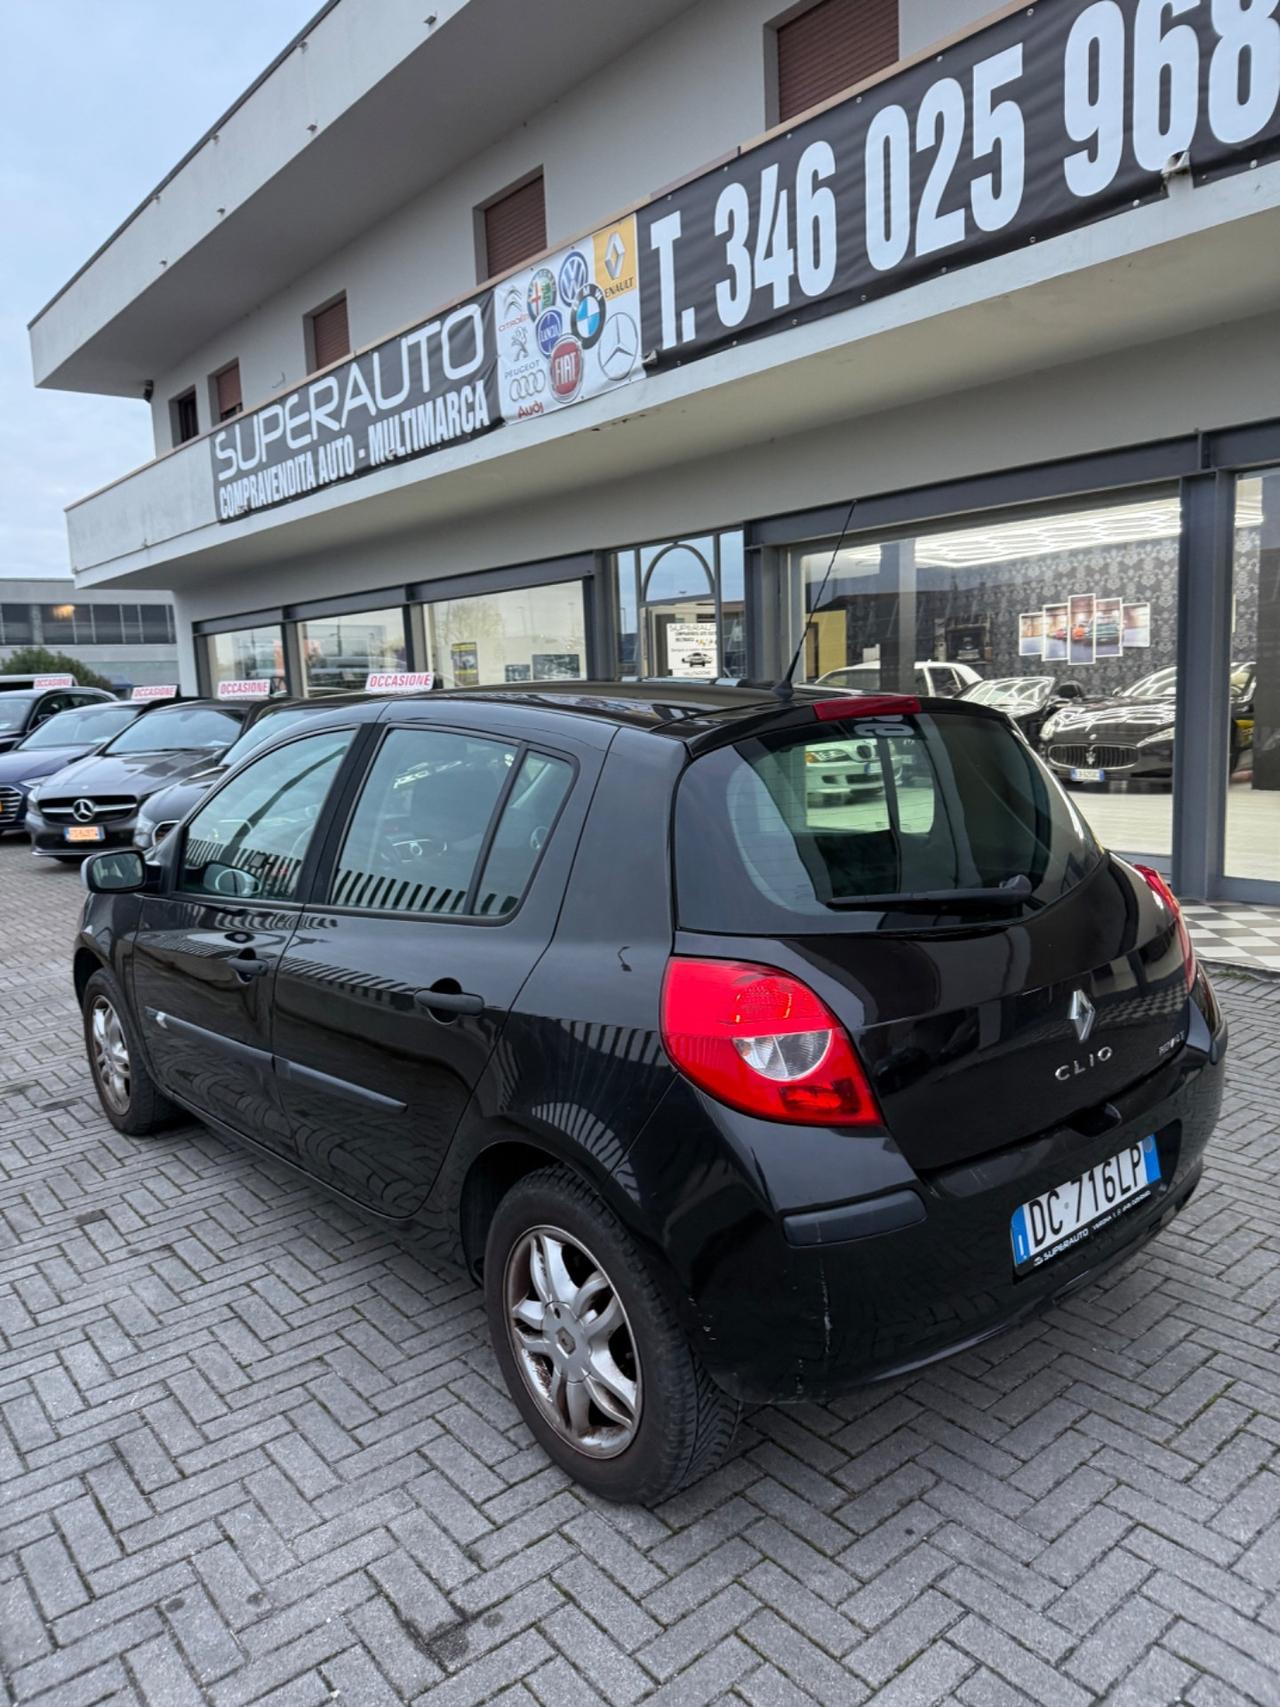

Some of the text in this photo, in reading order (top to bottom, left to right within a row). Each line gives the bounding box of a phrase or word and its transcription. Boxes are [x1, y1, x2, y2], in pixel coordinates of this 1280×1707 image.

[650, 0, 1280, 350] T. 346 025 968
[604, 277, 634, 299] ENAULT
[504, 359, 540, 379] PEUGEOT
[554, 352, 577, 386] FIAT
[215, 303, 484, 481] SUPERAUTO
[517, 400, 544, 418] Audi
[219, 452, 316, 519] COMPRAVENDITA
[318, 434, 355, 485] AUTO
[368, 379, 490, 467] MULTIMARCA
[133, 687, 176, 698] OCCASIONE
[219, 681, 269, 696] OCCASIONE
[369, 674, 430, 689] OCCASIONE
[1055, 1046, 1113, 1081] CLIO
[1029, 1189, 1064, 1248] DC
[1068, 1144, 1142, 1222] 716LP
